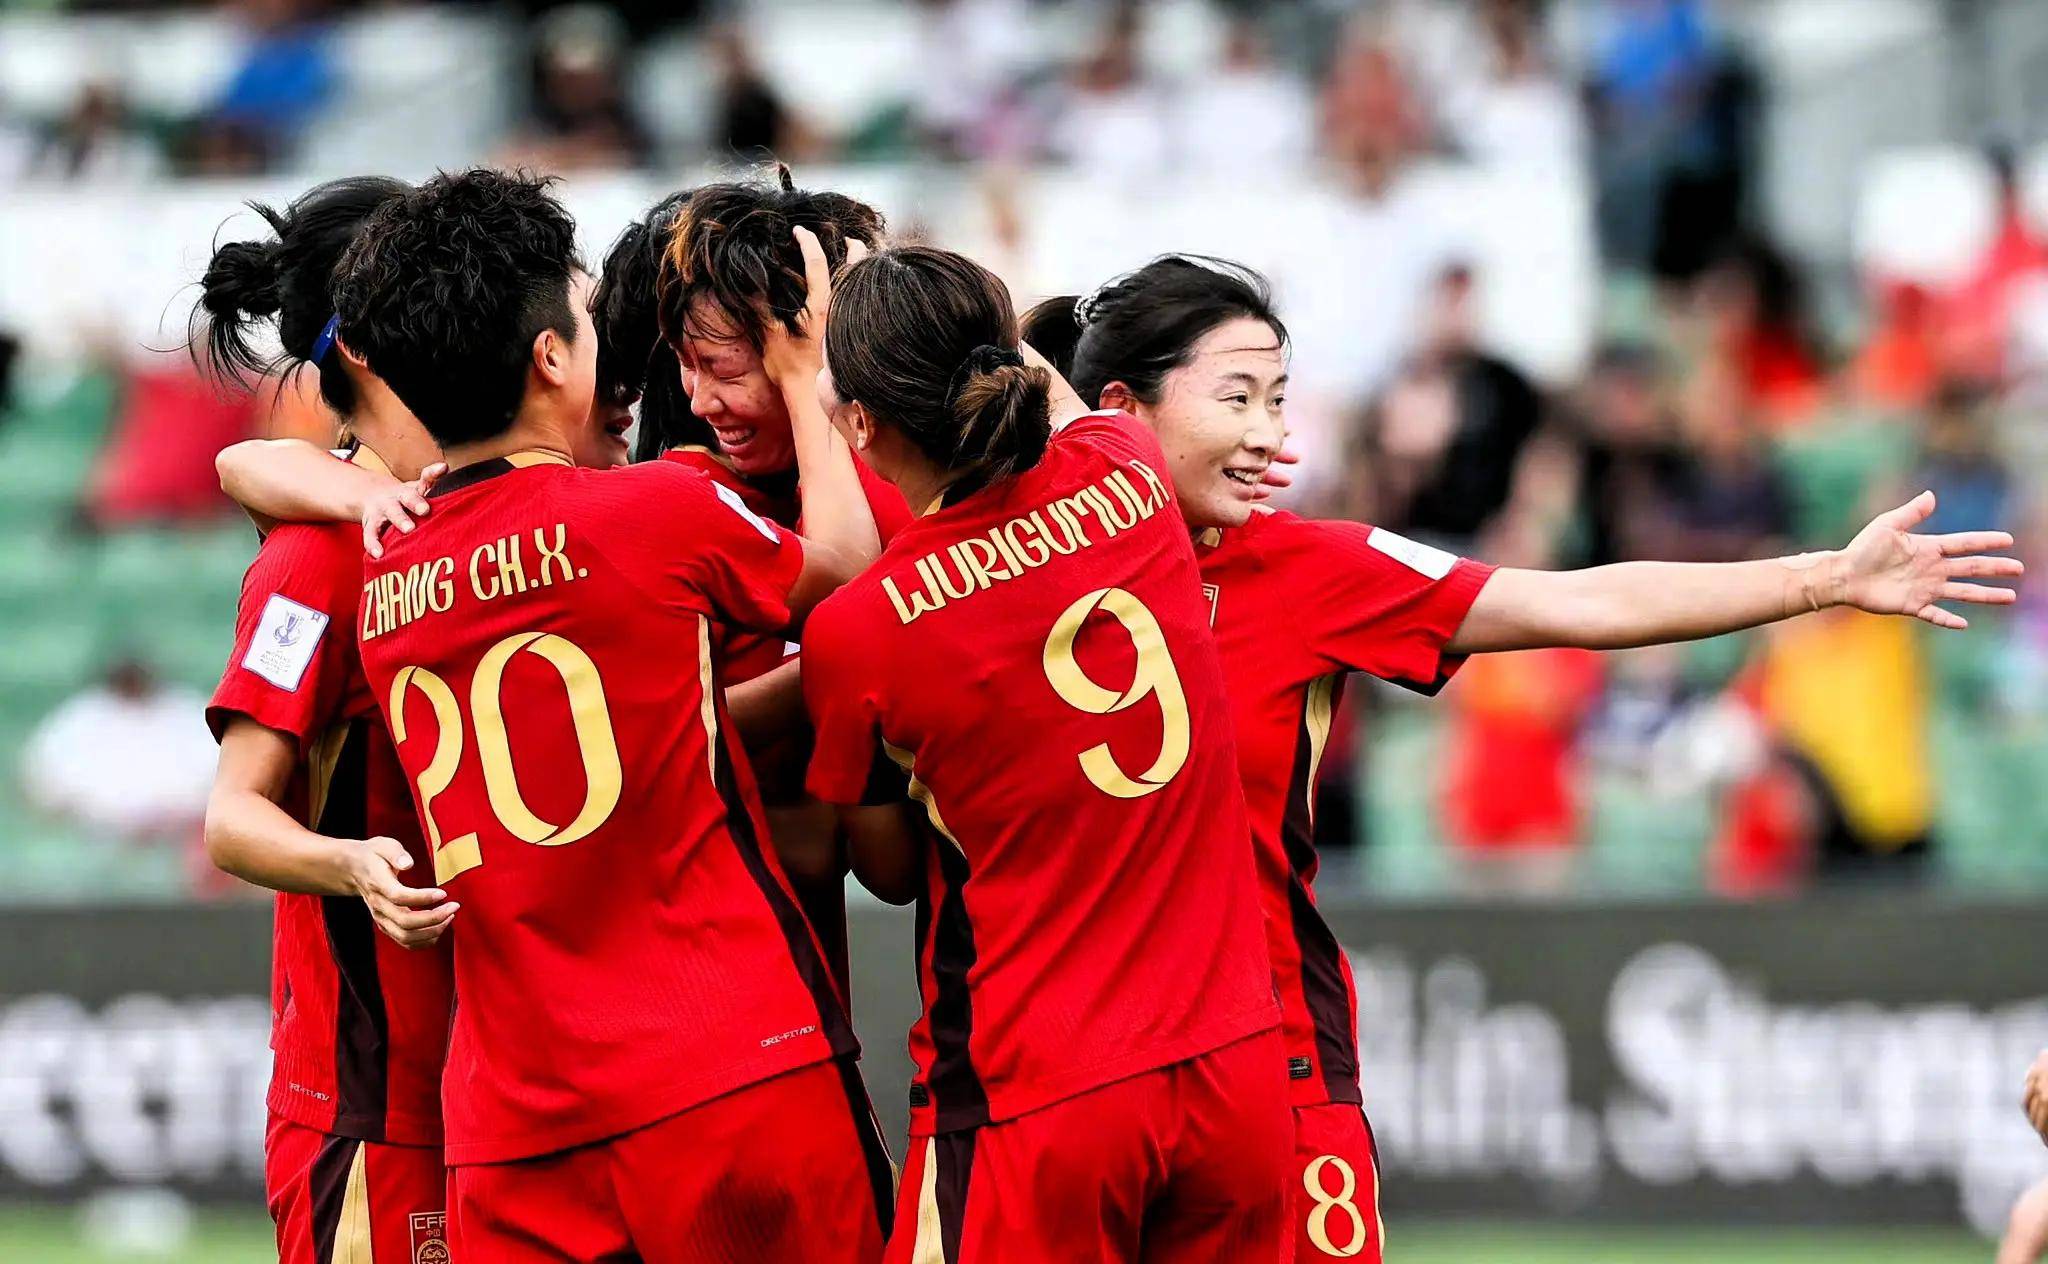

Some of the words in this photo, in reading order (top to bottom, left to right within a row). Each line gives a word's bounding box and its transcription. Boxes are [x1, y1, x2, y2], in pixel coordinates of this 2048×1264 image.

[362, 556, 455, 642] ZHANG
[469, 523, 588, 601] CH.X.
[881, 459, 1170, 625] WURIGUMULA
[389, 631, 623, 887] 20
[1042, 586, 1191, 799] 9
[1302, 1154, 1367, 1258] 8
